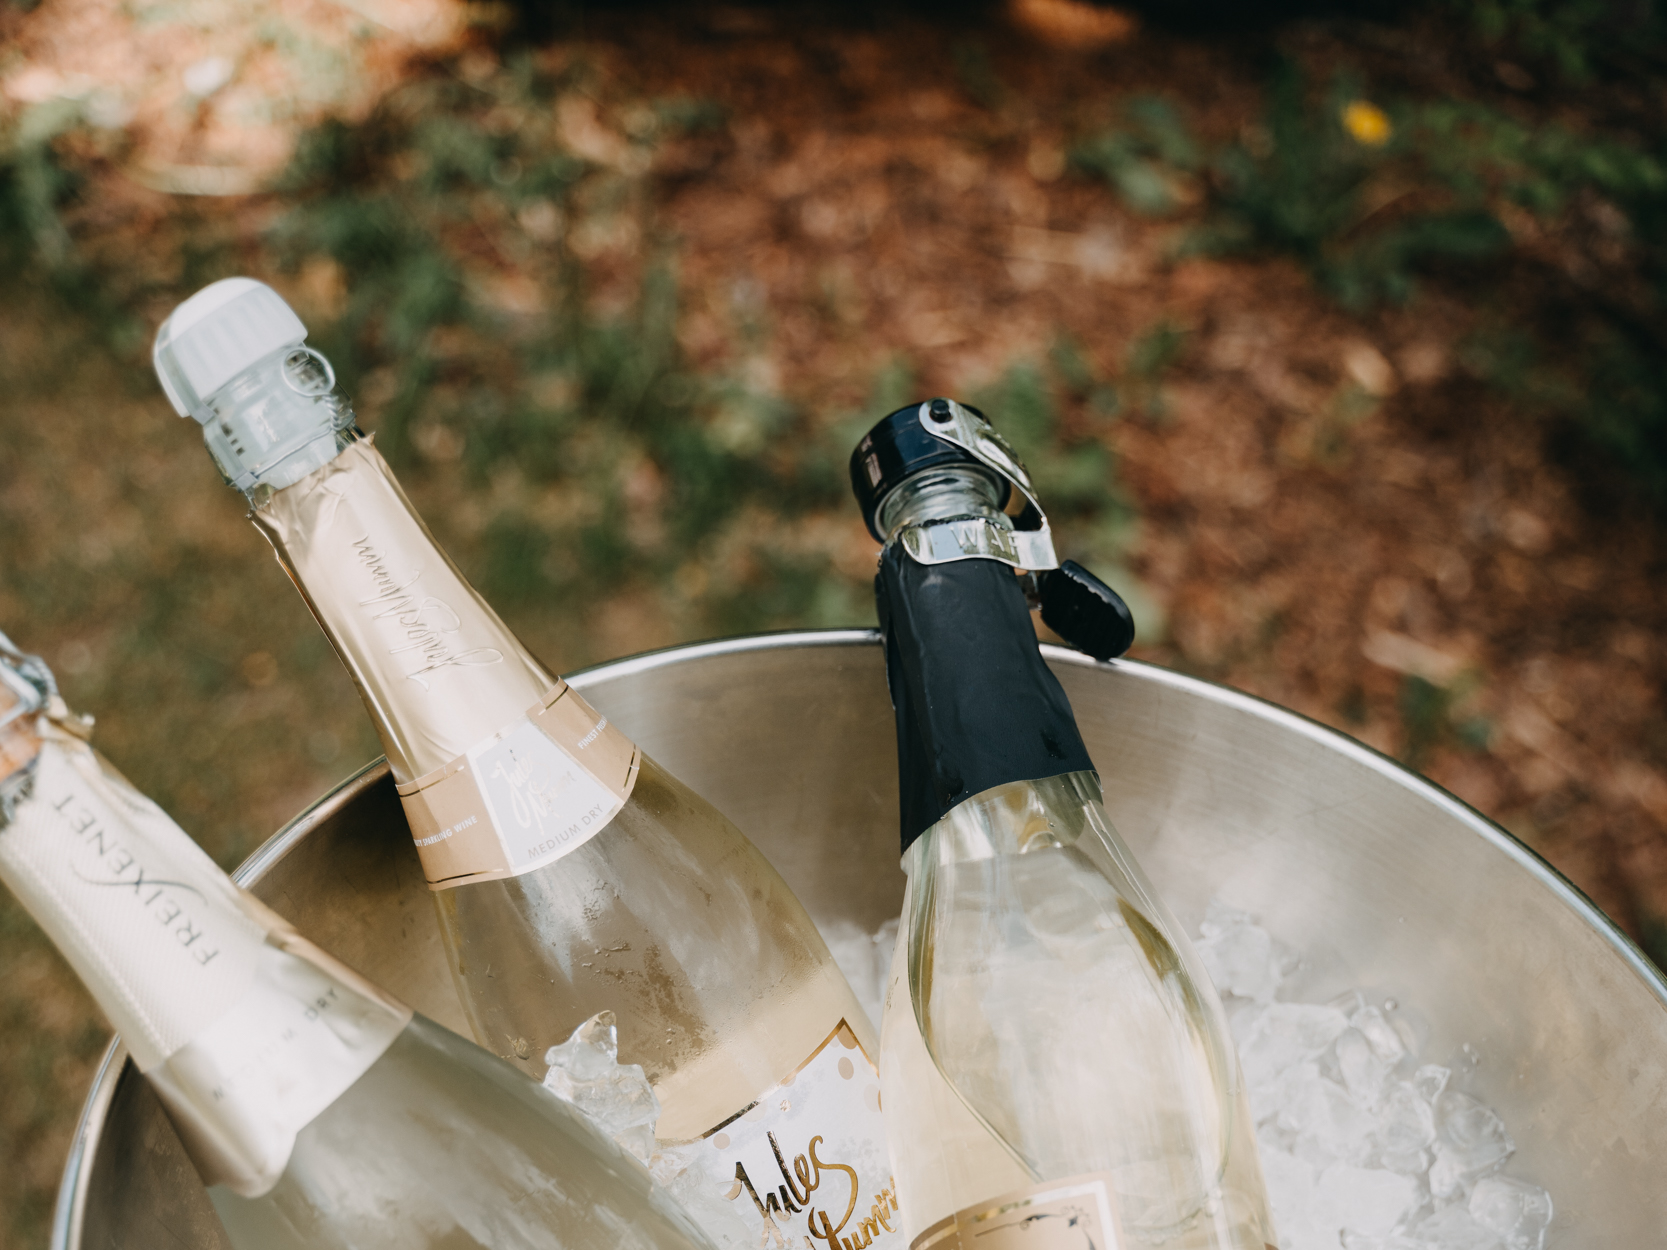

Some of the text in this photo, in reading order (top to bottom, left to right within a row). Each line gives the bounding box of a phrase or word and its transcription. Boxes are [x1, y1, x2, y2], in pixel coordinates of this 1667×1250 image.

[577, 728, 599, 750] FINEST
[422, 828, 453, 847] SPARKLING
[453, 815, 478, 833] WINE
[528, 803, 605, 859] MEDIUM DRY
[54, 794, 219, 966] FREIXENET
